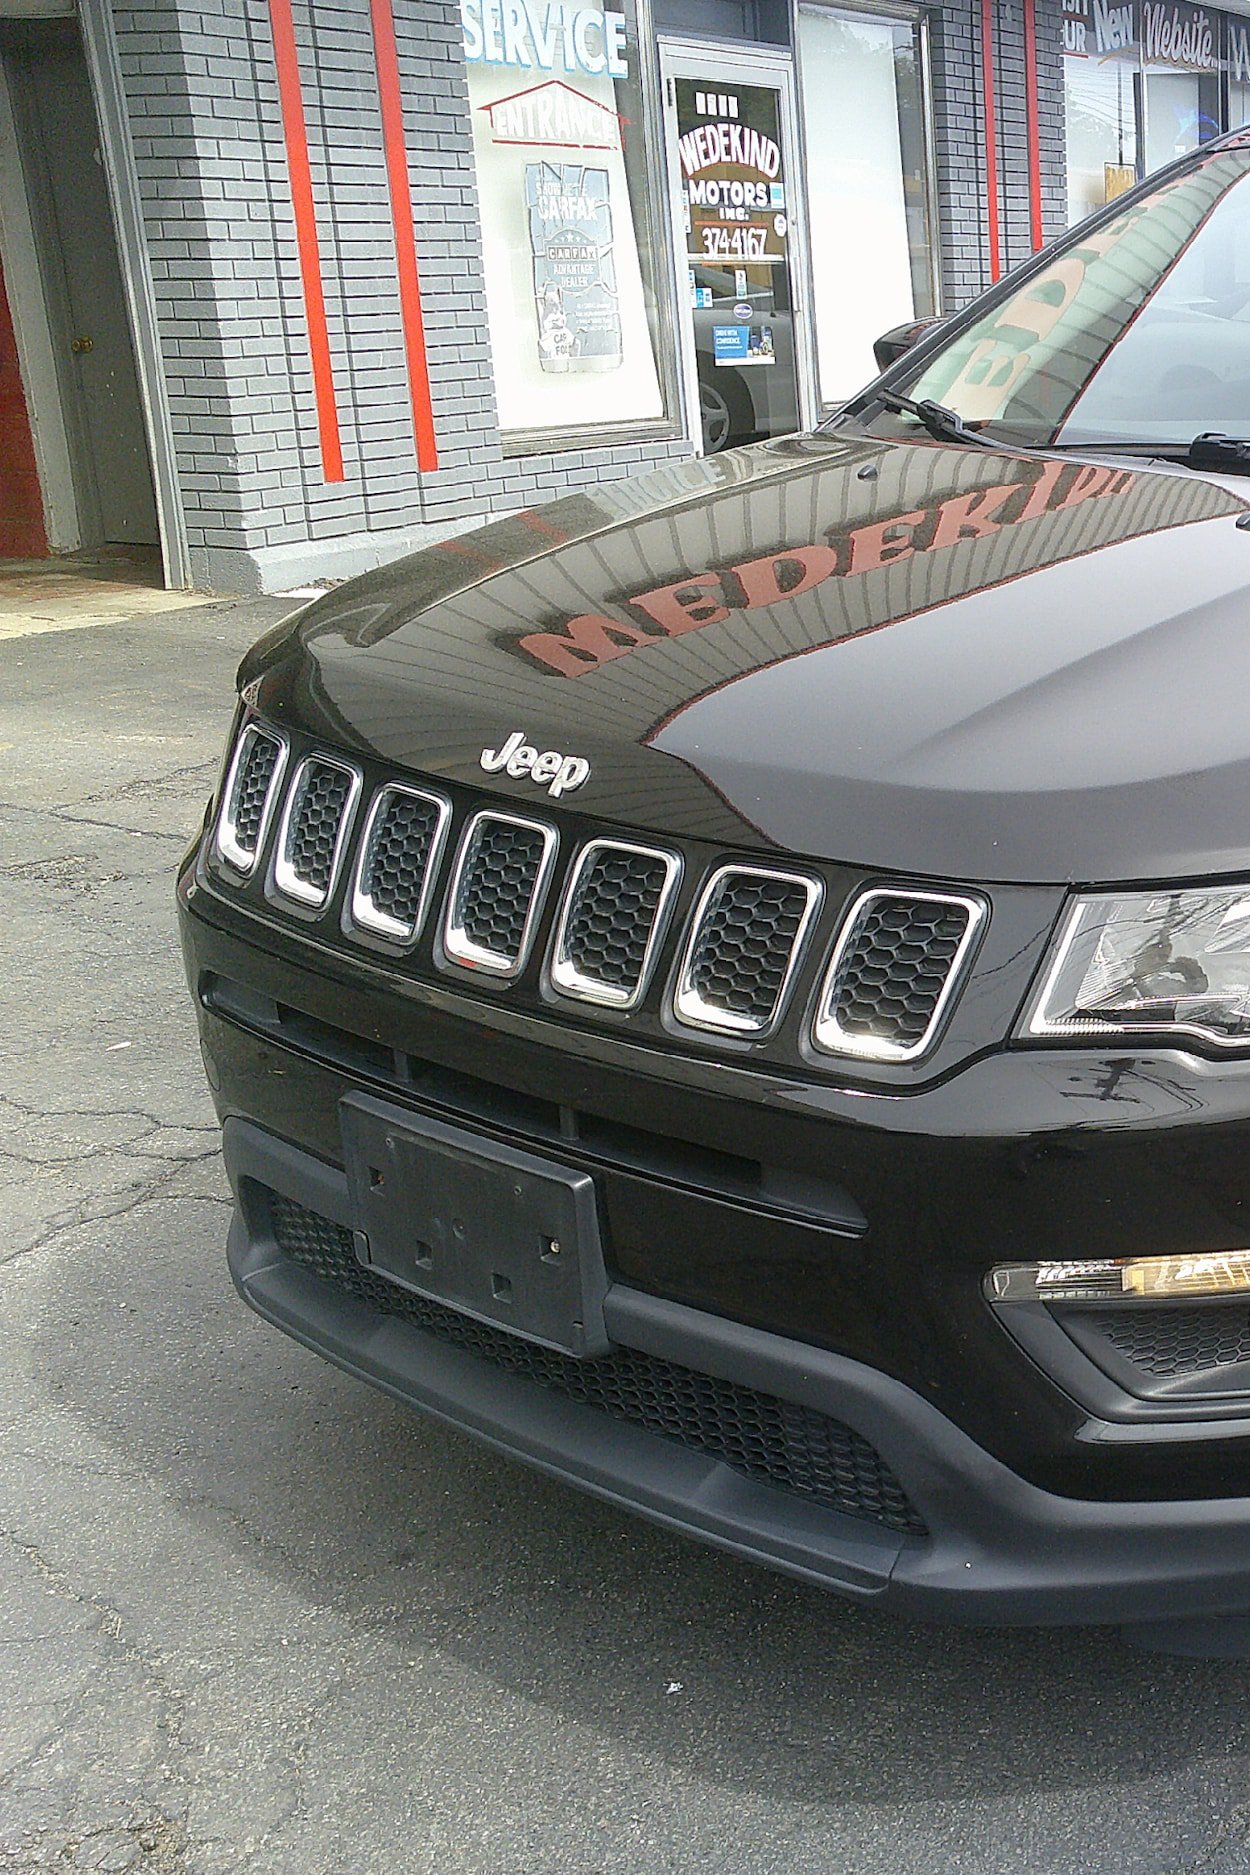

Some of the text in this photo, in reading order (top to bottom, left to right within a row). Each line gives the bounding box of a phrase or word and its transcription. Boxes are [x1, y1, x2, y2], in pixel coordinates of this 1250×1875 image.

[462, 0, 628, 79] SERVICE
[496, 93, 616, 140] ENTRANCE
[679, 123, 780, 179] WEDEKIND
[537, 196, 598, 221] CARFAX
[689, 180, 768, 207] MOTORS
[720, 207, 749, 220] INC.
[548, 247, 596, 260] CARFAX
[702, 228, 767, 260] 374-4167
[480, 732, 592, 799] Jeep
